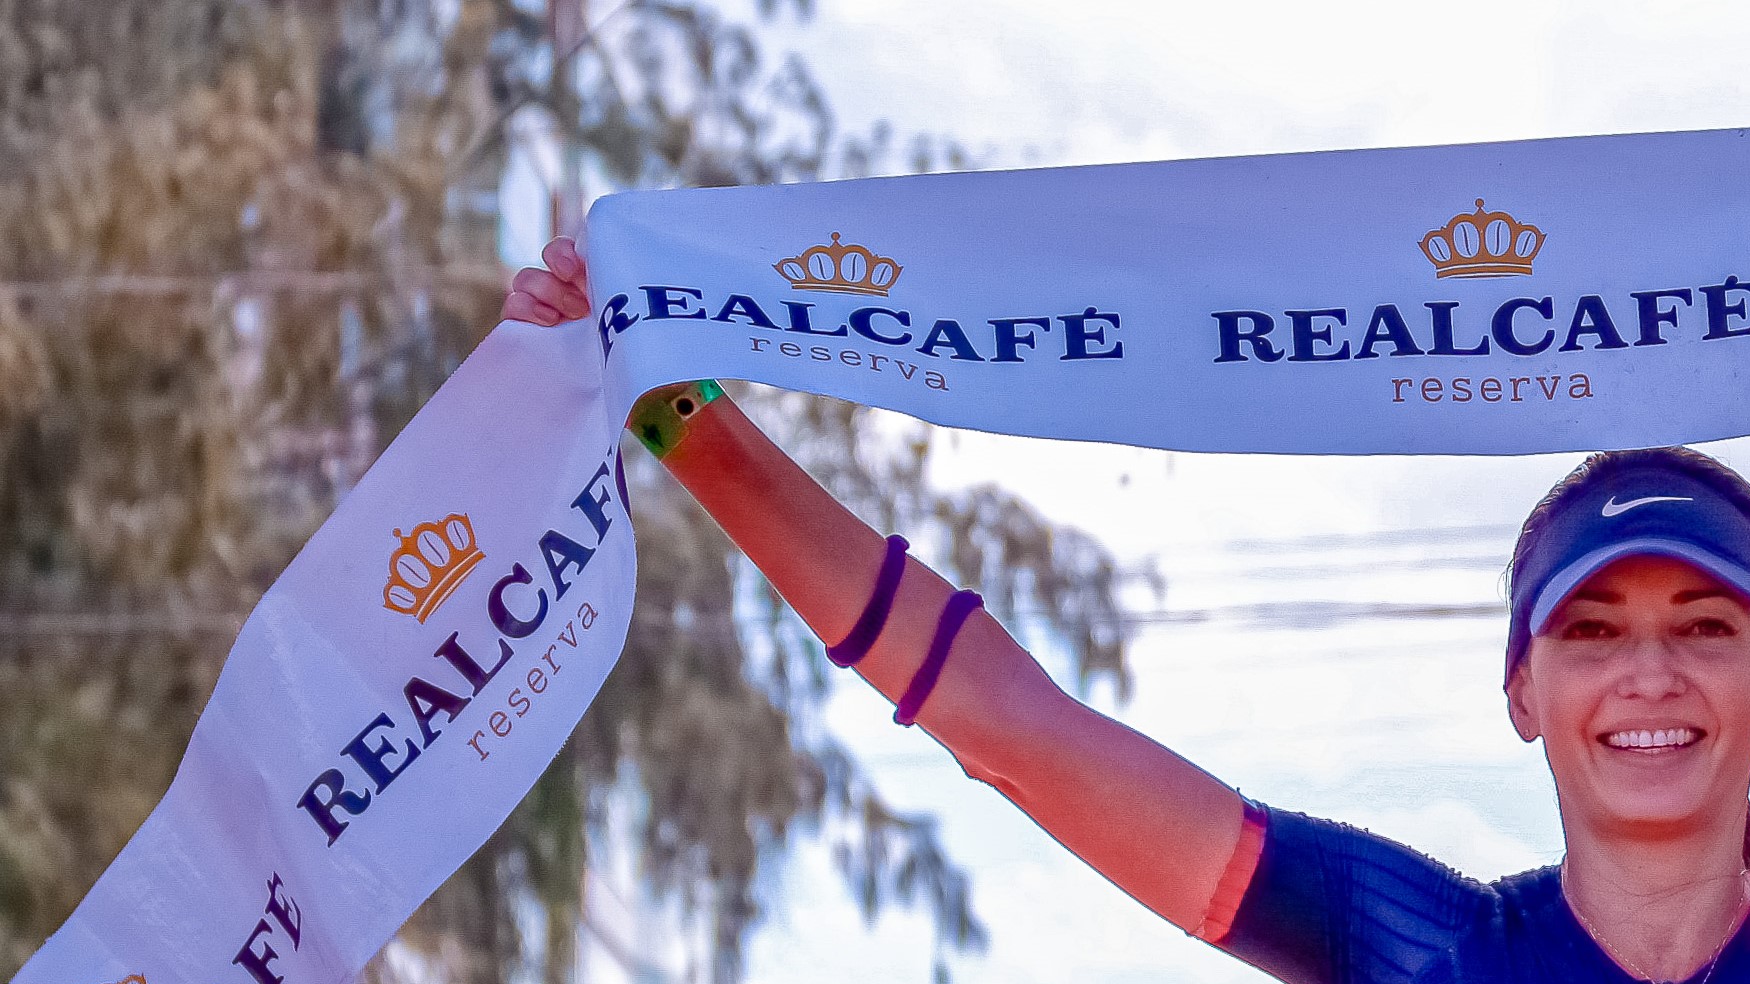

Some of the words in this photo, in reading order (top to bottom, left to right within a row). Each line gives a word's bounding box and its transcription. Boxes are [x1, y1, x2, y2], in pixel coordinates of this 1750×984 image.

[597, 285, 1124, 369] REALCAFÉ
[749, 336, 949, 392] reserva
[1391, 370, 1594, 403] reserva
[296, 445, 614, 848] REALCAF
[466, 600, 599, 762] reserva
